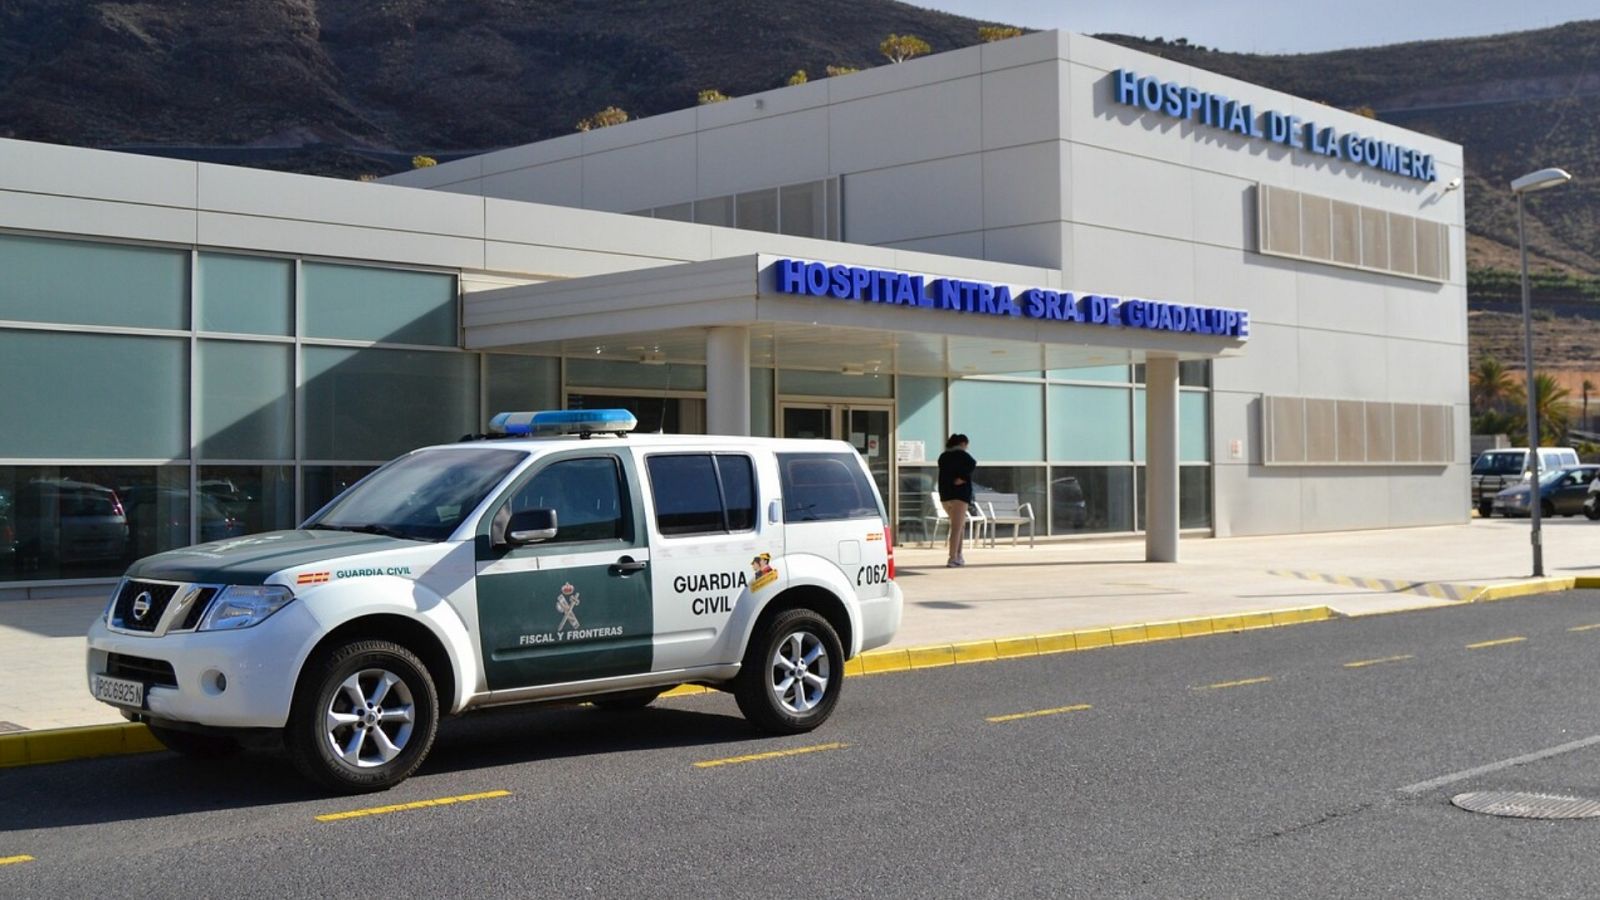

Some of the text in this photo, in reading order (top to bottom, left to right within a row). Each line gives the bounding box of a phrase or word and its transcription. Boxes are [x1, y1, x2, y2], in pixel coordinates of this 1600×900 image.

[1115, 69, 1438, 182] HOSPITAL DE LA GOMERA
[778, 259, 932, 307] HOSPITAL
[1027, 288, 1085, 323] SRA.
[1089, 295, 1120, 326] DE
[1125, 300, 1249, 337] GUADALUPE
[336, 566, 411, 579] GUARDIA CIVIL
[673, 571, 748, 594] GUARDIA
[865, 563, 888, 586] 062
[692, 597, 731, 615] CIVIL
[520, 626, 623, 645] FISCAL Y FRONTERAS
